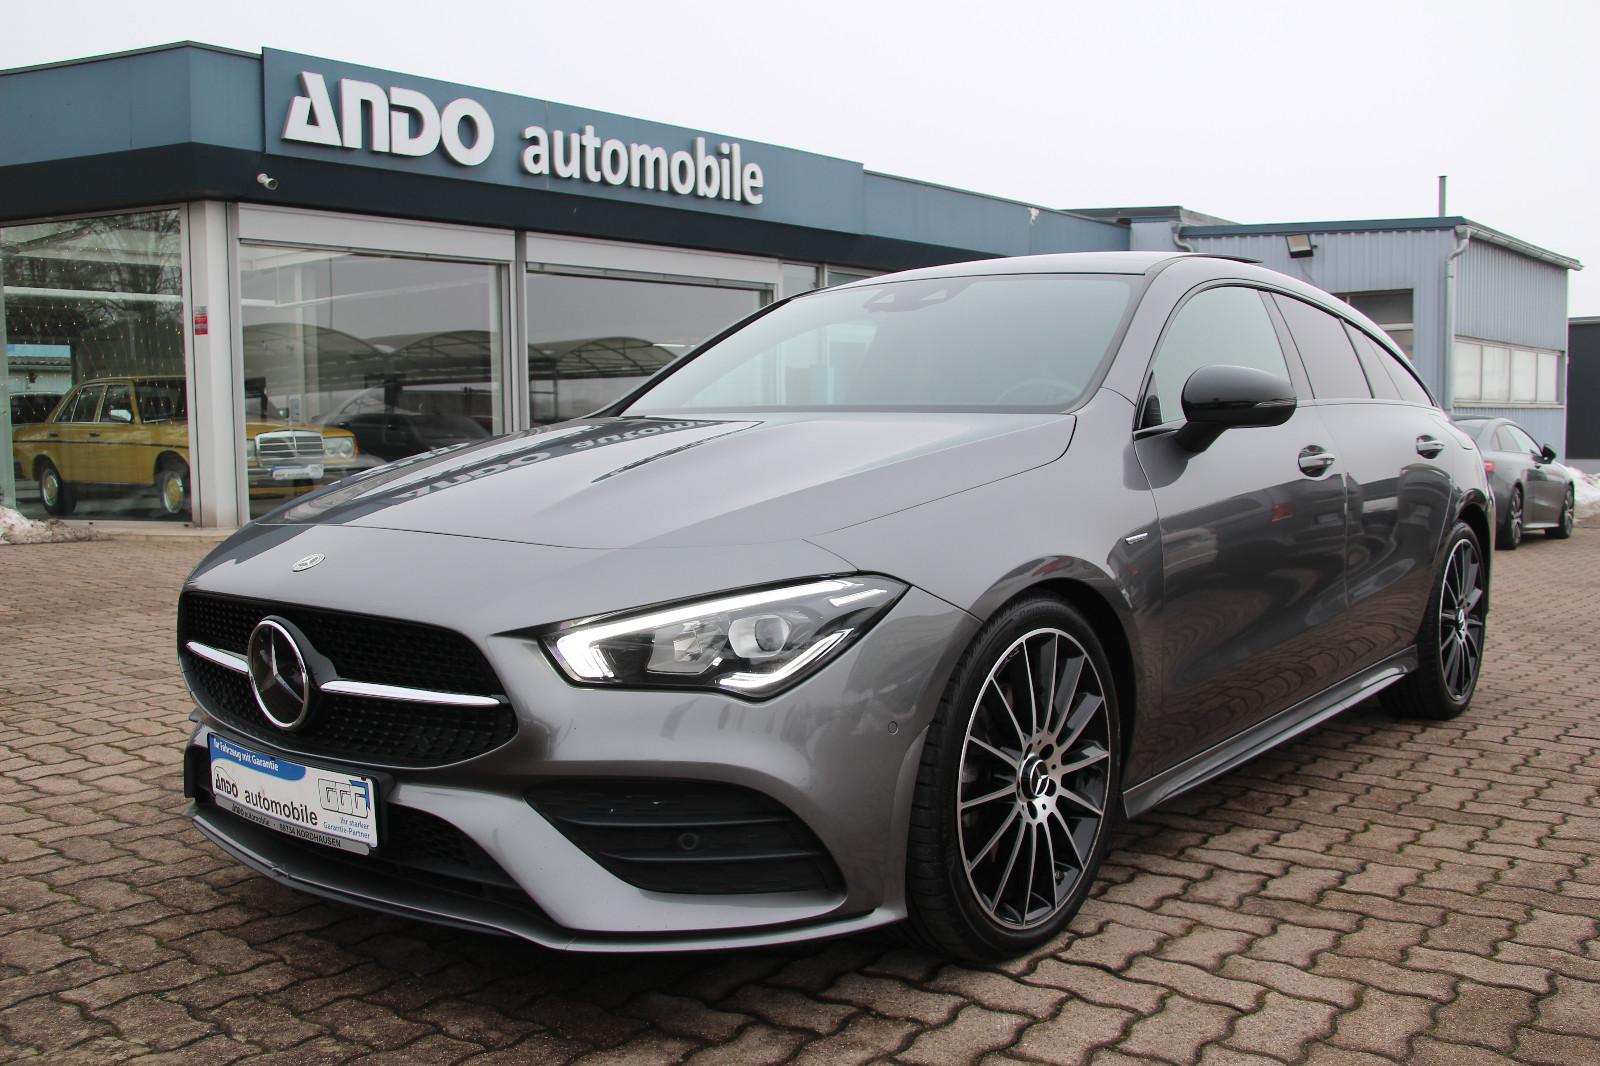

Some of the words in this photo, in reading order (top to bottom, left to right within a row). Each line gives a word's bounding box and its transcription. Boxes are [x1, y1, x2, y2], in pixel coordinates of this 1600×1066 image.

[282, 71, 495, 167] ANDO
[518, 124, 764, 205] automobile
[242, 752, 252, 764] mit
[252, 755, 279, 772] Garantie
[215, 774, 239, 799] ANDO
[244, 789, 318, 826] automobile
[323, 820, 370, 840] Garantie-Partner
[349, 820, 369, 830] starker
[296, 828, 341, 848] NORDHAUSEN
